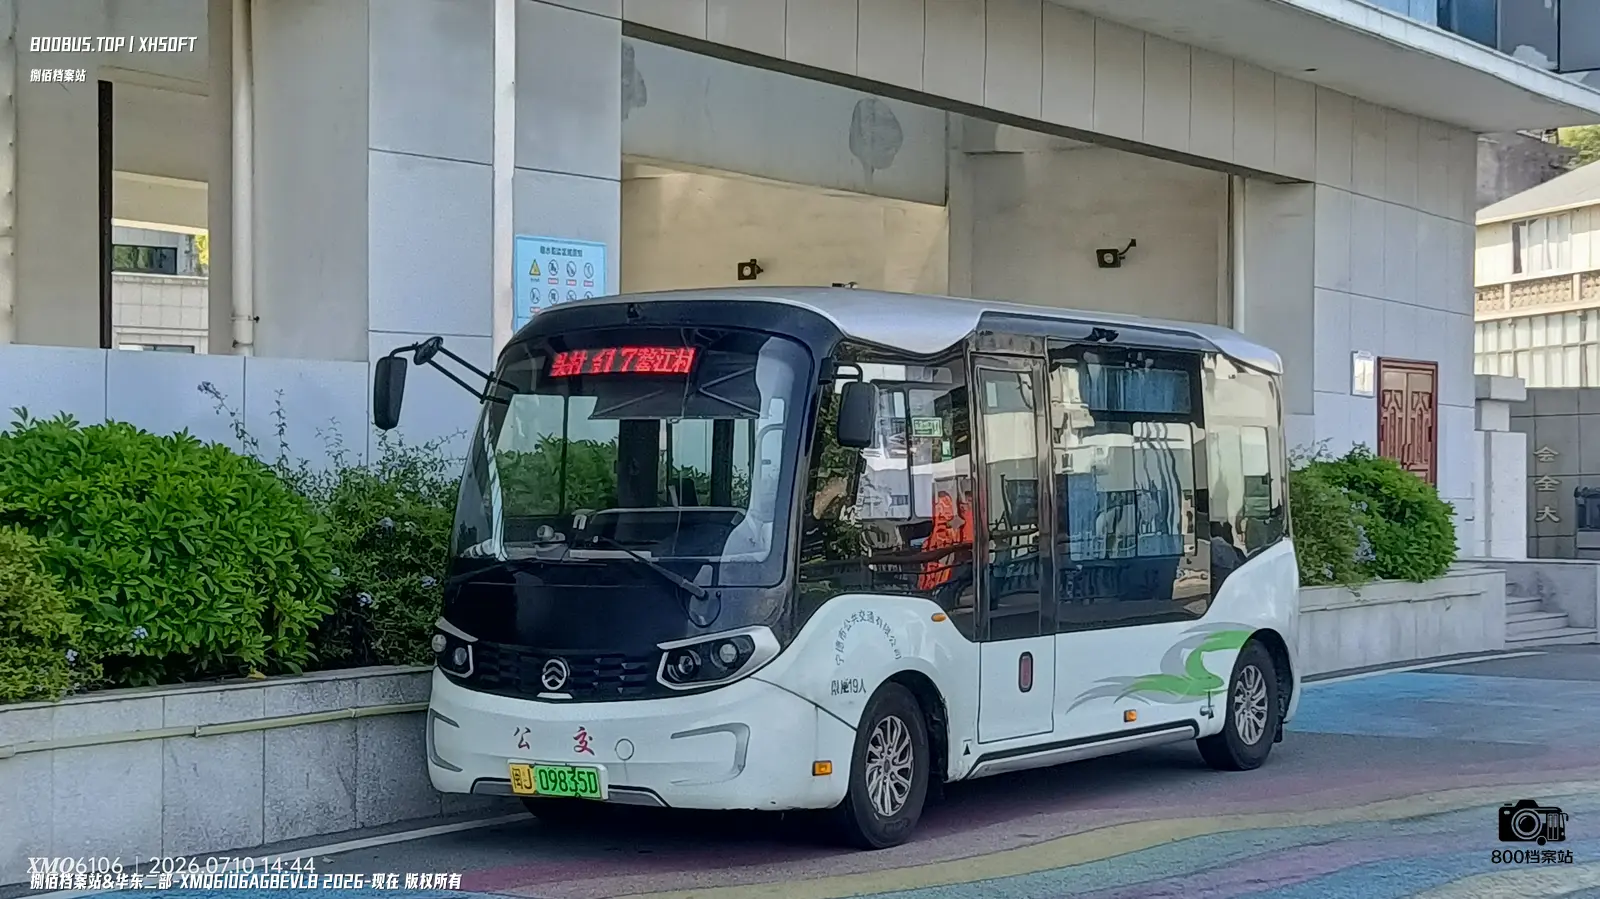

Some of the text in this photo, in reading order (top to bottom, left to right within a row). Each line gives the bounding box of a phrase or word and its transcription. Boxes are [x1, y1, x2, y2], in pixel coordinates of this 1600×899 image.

[835, 610, 902, 666] 宁德市公共交通有限公司
